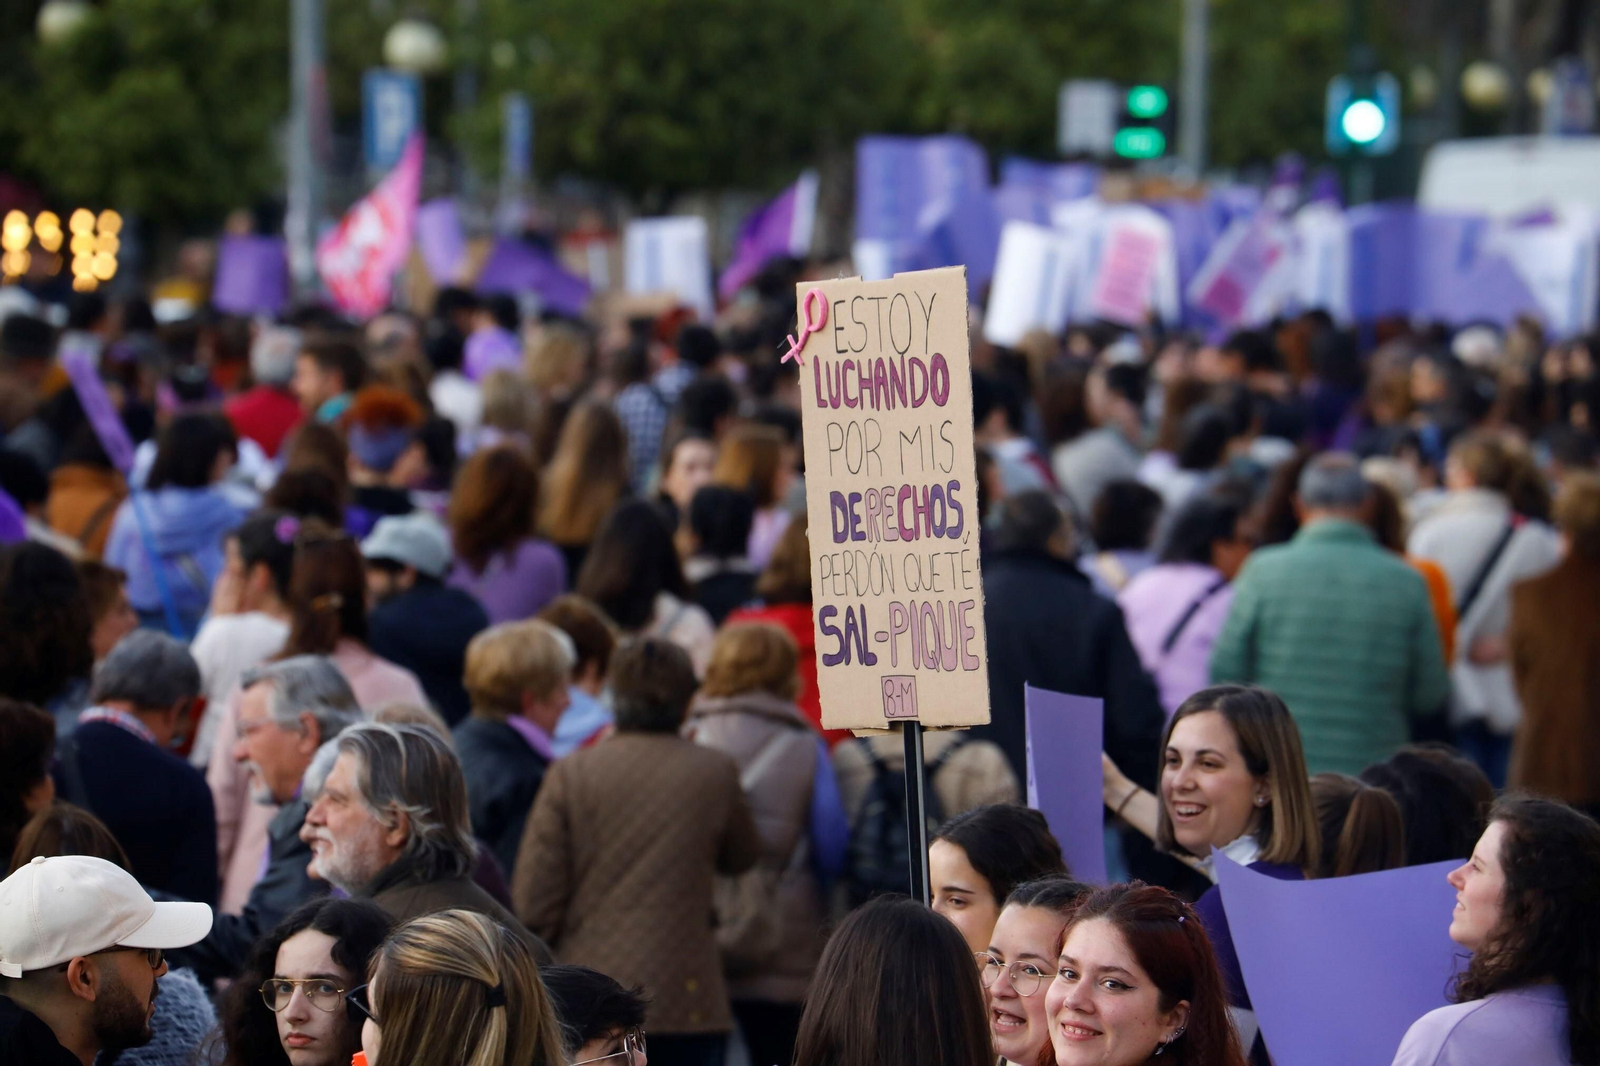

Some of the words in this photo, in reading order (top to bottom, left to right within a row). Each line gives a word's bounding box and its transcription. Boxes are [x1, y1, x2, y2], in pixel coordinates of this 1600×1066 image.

[833, 291, 937, 354] ESTOY
[813, 353, 950, 411] LUCHANDO
[827, 418, 883, 476] POR
[899, 420, 954, 475] MIS
[819, 543, 895, 597] PERDÓN
[819, 599, 980, 673] SAL-PIQUE
